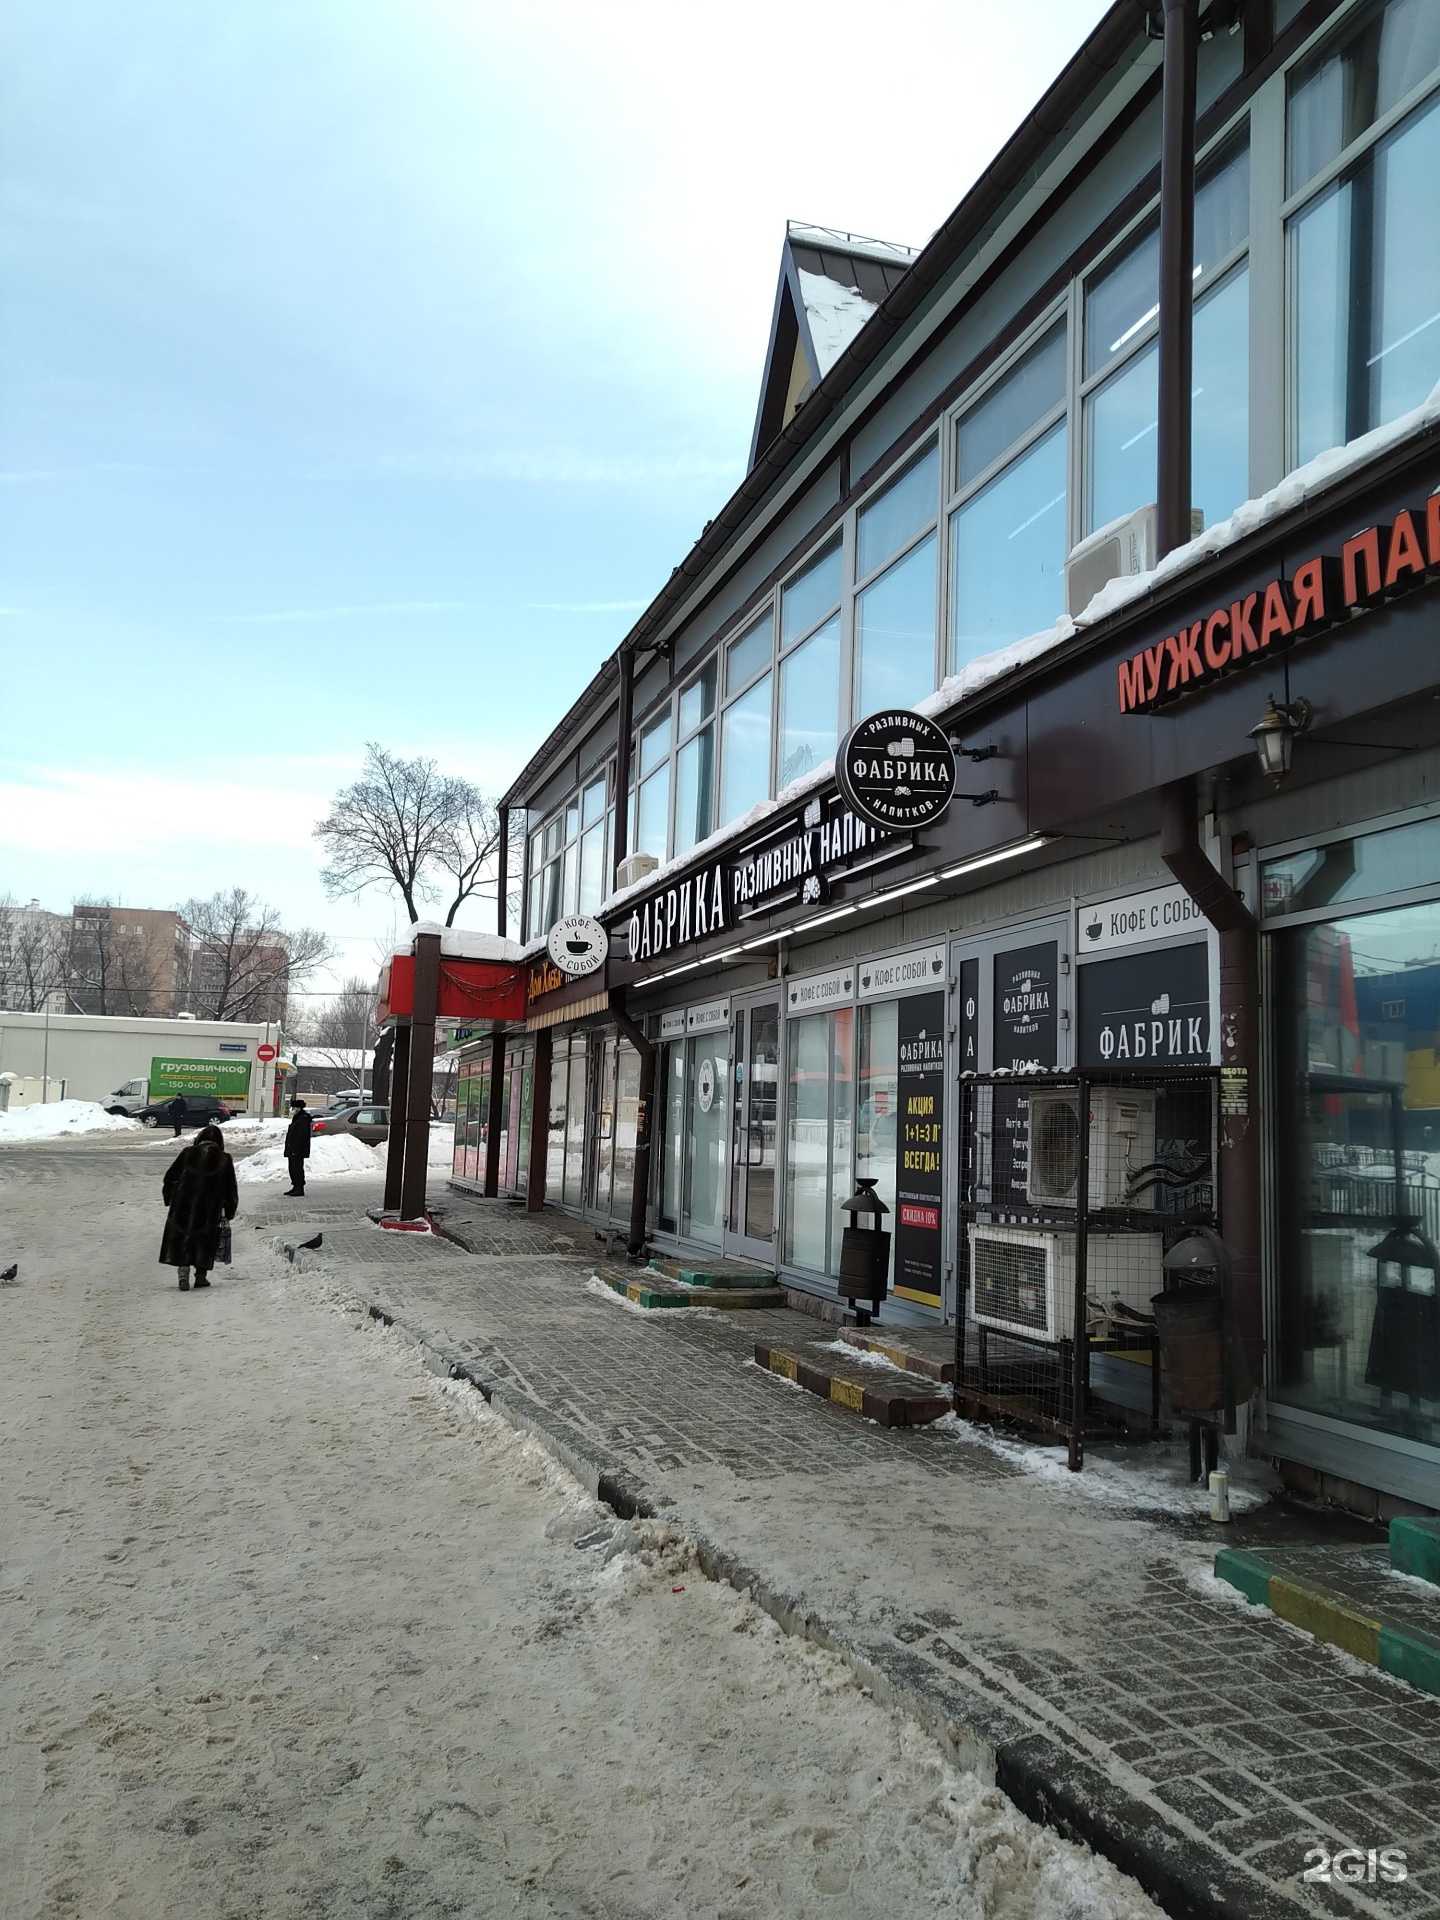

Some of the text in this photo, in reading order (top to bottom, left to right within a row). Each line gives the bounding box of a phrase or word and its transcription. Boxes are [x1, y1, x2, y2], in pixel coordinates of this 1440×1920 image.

[1118, 555, 1325, 714] МУЖСКАЯ
[868, 716, 931, 736] РАЗЛИВНЫХ
[853, 759, 950, 781] ФАБРИКА
[873, 799, 934, 818] НАПИТКОВ
[629, 864, 725, 963] ФАБРИКА
[734, 831, 812, 904] РАЗЛИВНЫХ
[564, 918, 591, 929] КОФЕ
[1110, 896, 1205, 936] КОФЕ С СОБО
[558, 954, 566, 963] С
[874, 957, 927, 987] КОФЕ С СОБОЙ
[1003, 991, 1050, 1014] ФАБРИКА
[1100, 1017, 1211, 1059] ФАБРИК
[900, 1040, 943, 1061] ФАБРИКА
[160, 1063, 247, 1075] грузовичкоф
[907, 1096, 934, 1117] АКЦИЯ
[905, 1123, 930, 1142] 1+1=3
[904, 1150, 940, 1173] ВСЕГДА!
